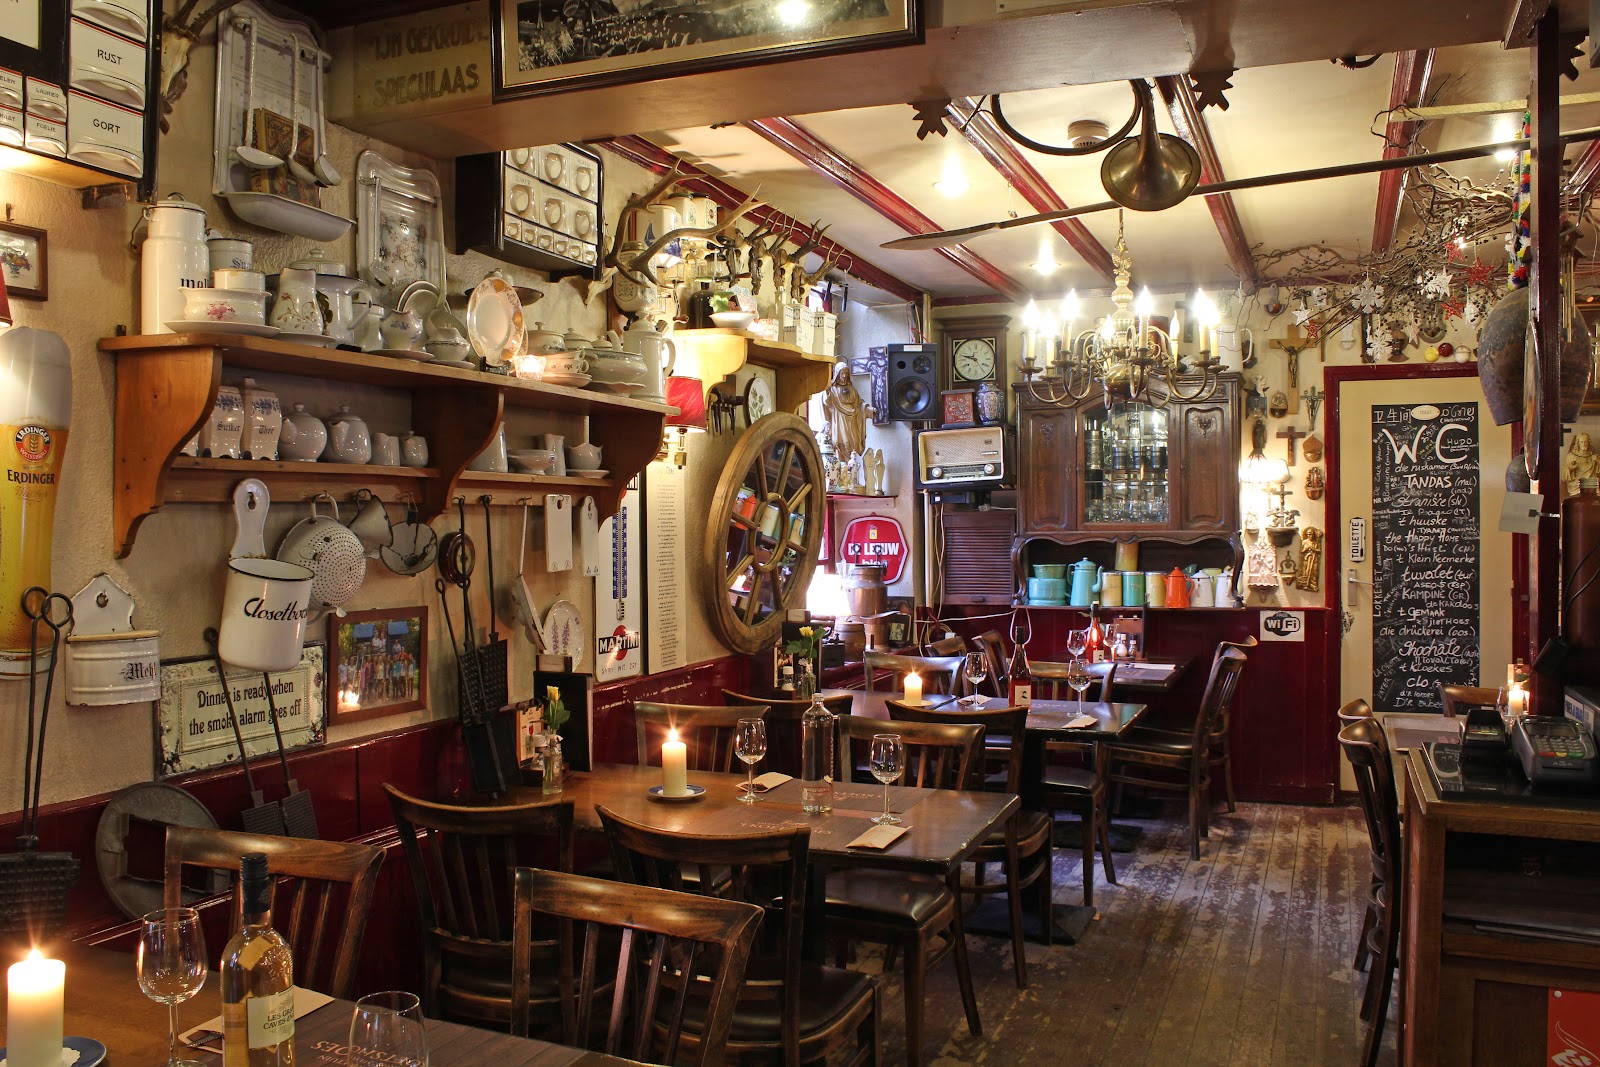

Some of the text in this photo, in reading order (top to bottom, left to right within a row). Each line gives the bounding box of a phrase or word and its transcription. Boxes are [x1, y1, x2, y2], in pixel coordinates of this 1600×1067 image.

[97, 49, 122, 65] RUST
[373, 63, 480, 108] SPECULAAS
[93, 118, 121, 134] GORT
[16, 426, 50, 443] ERDINGER
[7, 469, 55, 485] ERDINGER
[1402, 473, 1452, 489] TANDAS
[1351, 521, 1360, 558] TOILETTE
[599, 633, 640, 653] MARTINI
[197, 679, 294, 708] Dinne is ready when
[189, 718, 205, 735] the
[207, 712, 234, 733] smok
[239, 707, 266, 725] alarm
[289, 699, 302, 716] off
[263, 1018, 286, 1030] CAVES
